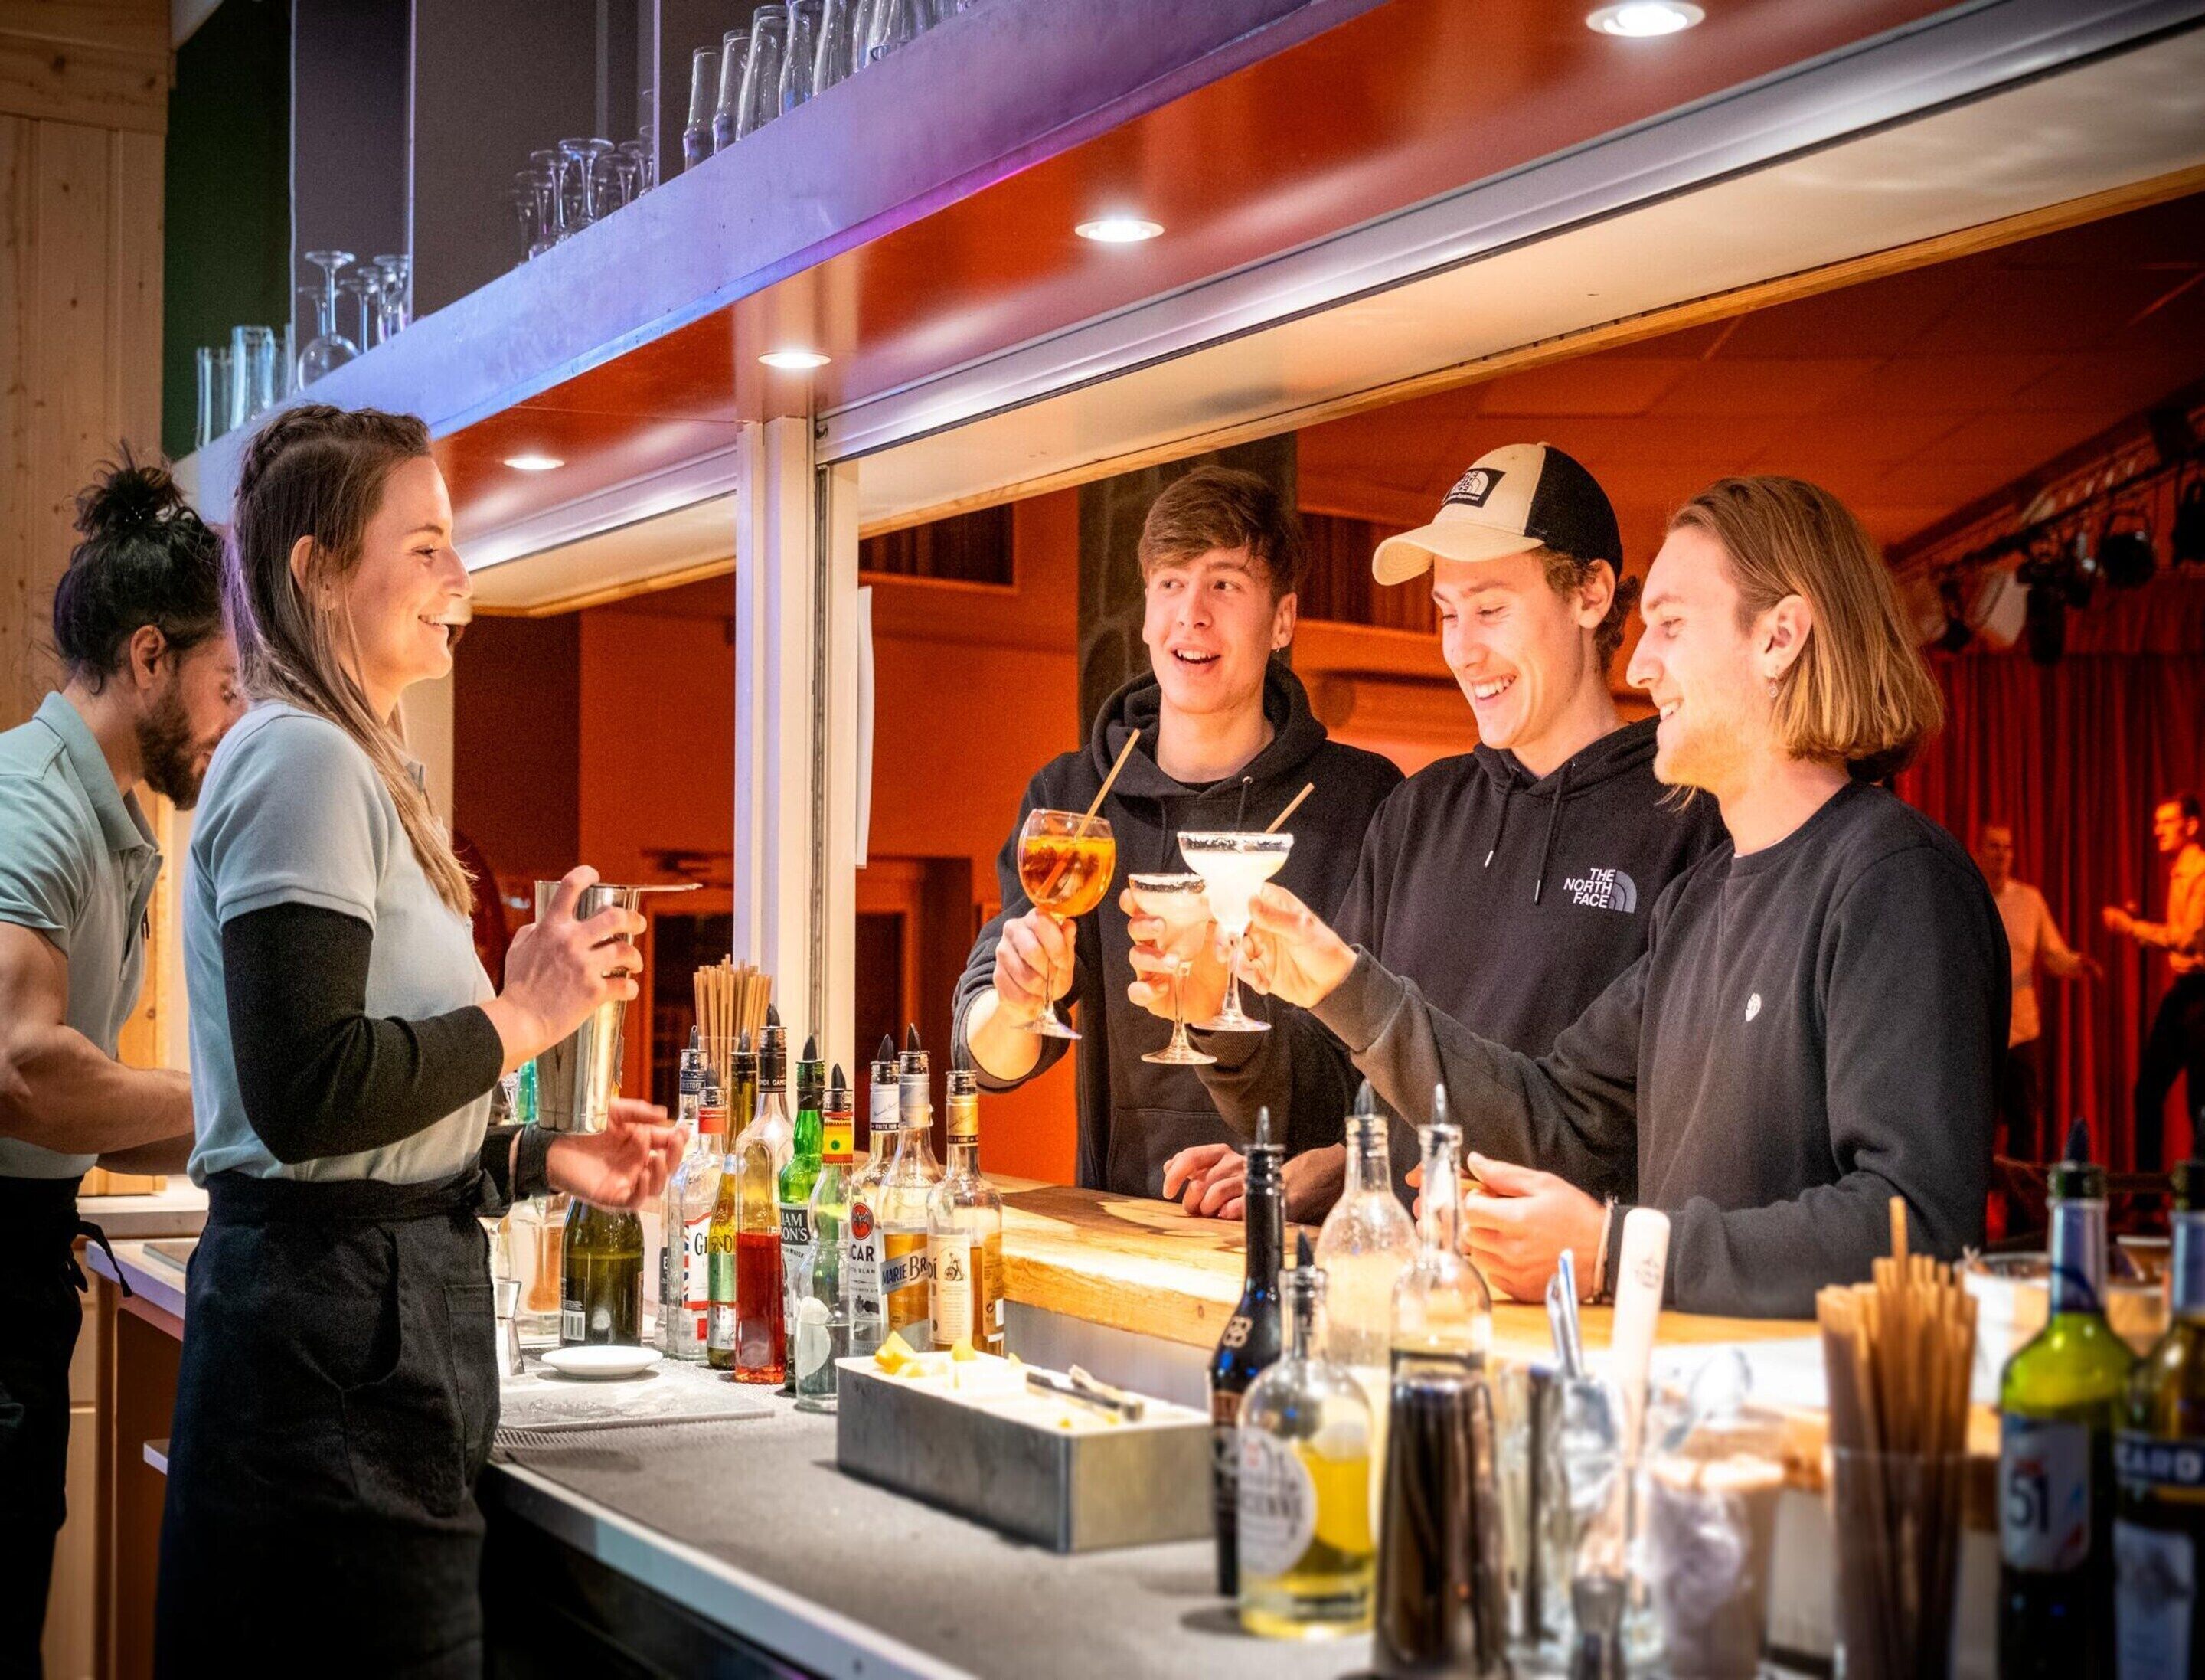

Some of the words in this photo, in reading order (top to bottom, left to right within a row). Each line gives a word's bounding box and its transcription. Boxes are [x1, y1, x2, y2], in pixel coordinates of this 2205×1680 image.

[1590, 868, 1615, 882] THE
[1563, 878, 1612, 895] NORTH
[1573, 891, 1609, 909] FACE
[882, 1263, 907, 1285] MARIE
[2007, 1468, 2049, 1534] 51
